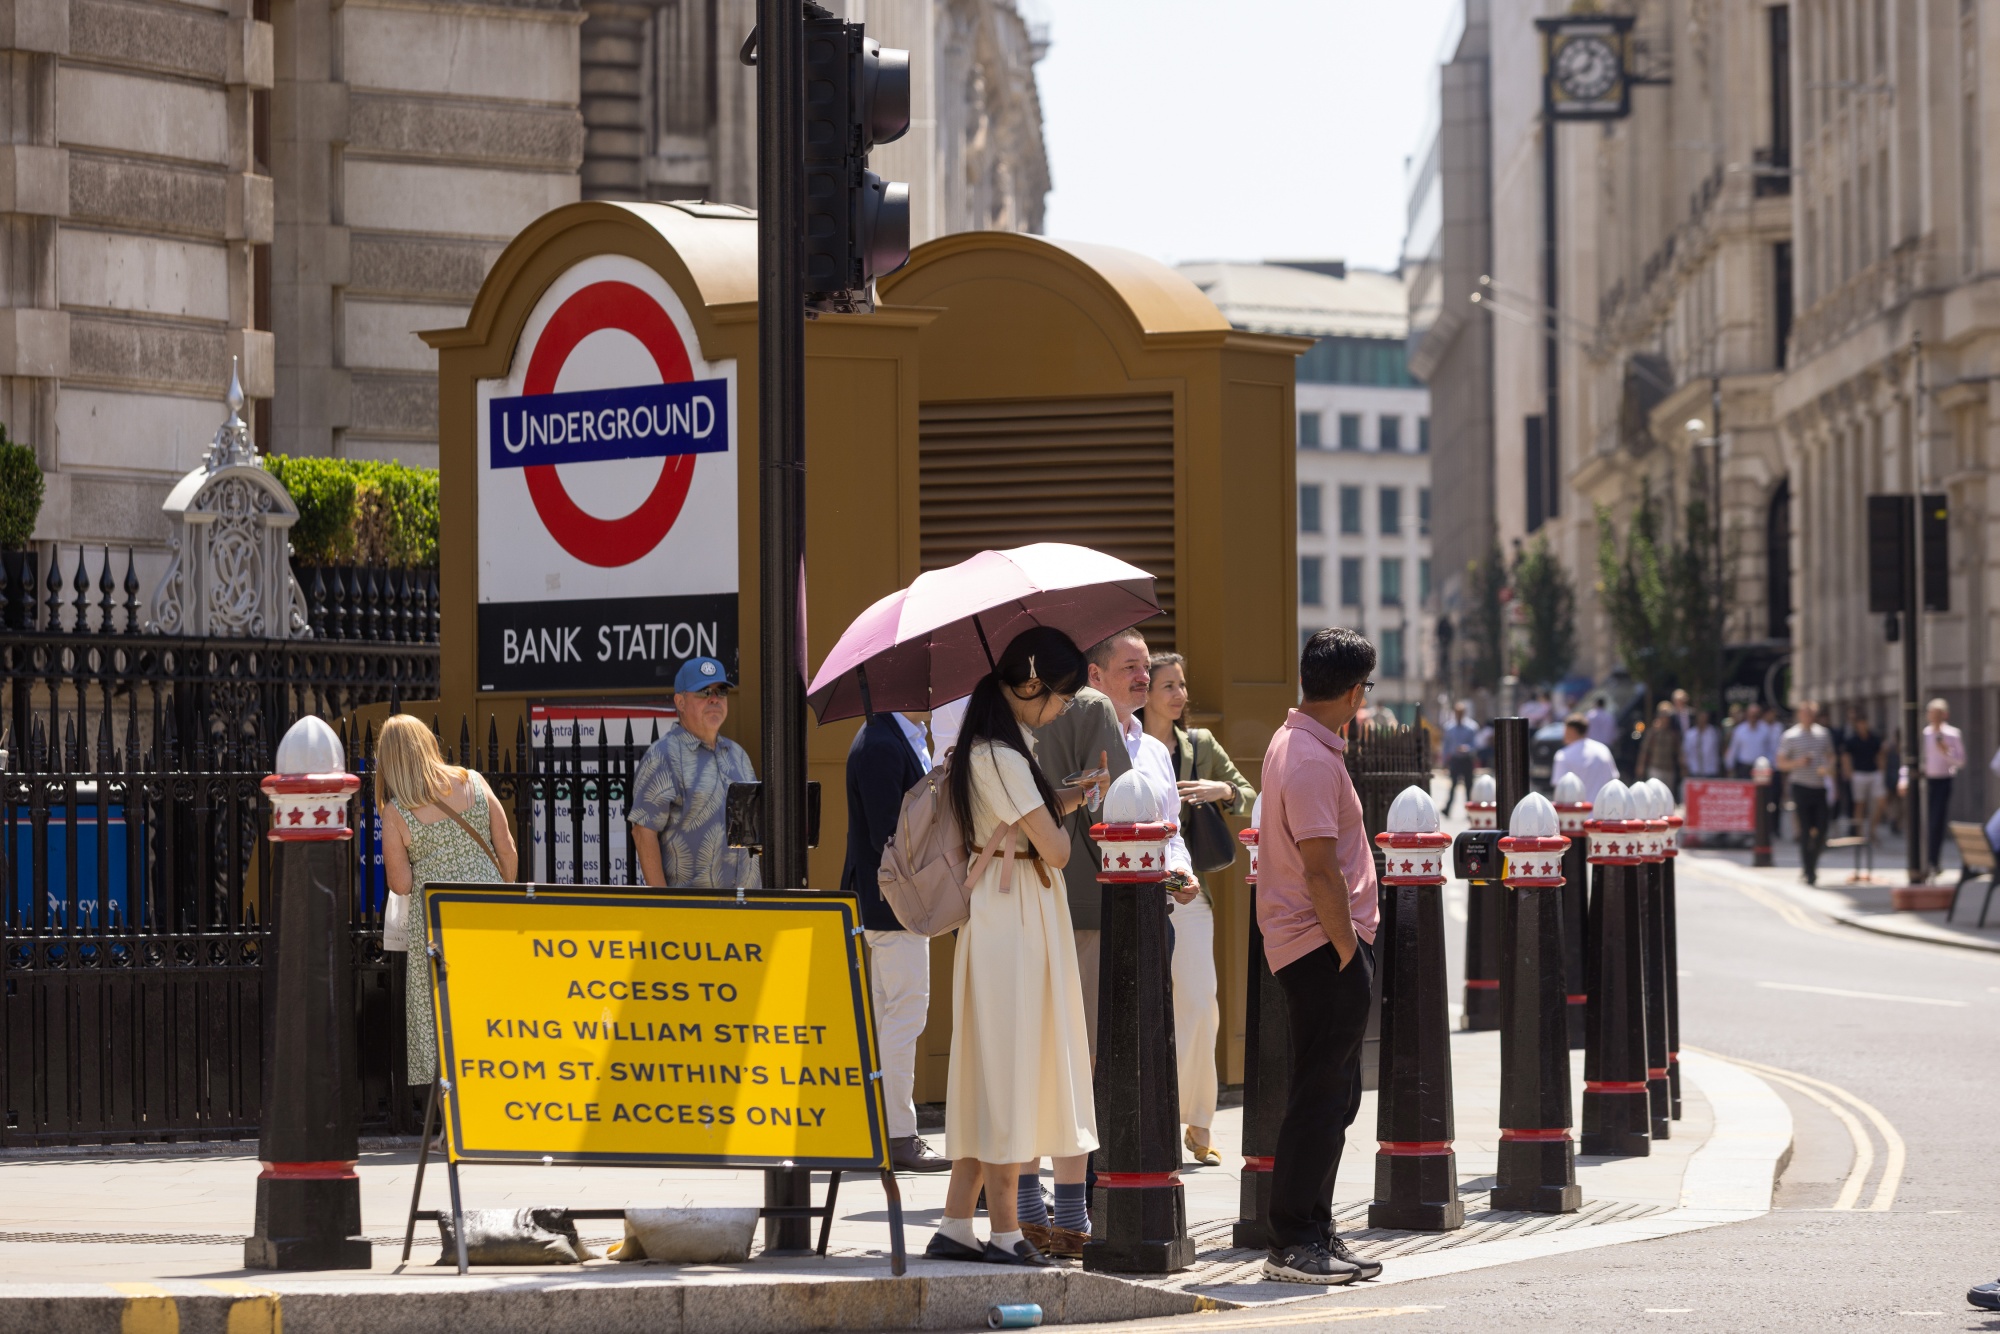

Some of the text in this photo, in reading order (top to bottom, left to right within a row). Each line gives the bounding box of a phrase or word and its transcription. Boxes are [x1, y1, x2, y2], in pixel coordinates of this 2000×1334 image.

[502, 395, 716, 454] UNDERGROUND
[503, 621, 717, 665] BANK STATION
[542, 724, 575, 737] Cntra
[587, 803, 595, 817] &
[533, 939, 763, 962] NO VEHICULAR
[567, 980, 738, 1003] ACCESS TO
[486, 1019, 827, 1045] KING WILLIAM STREET
[461, 1059, 862, 1086] FROM ST. SWITHIN'S LANE
[505, 1102, 826, 1127] CYCLE ACCESS ONLY
